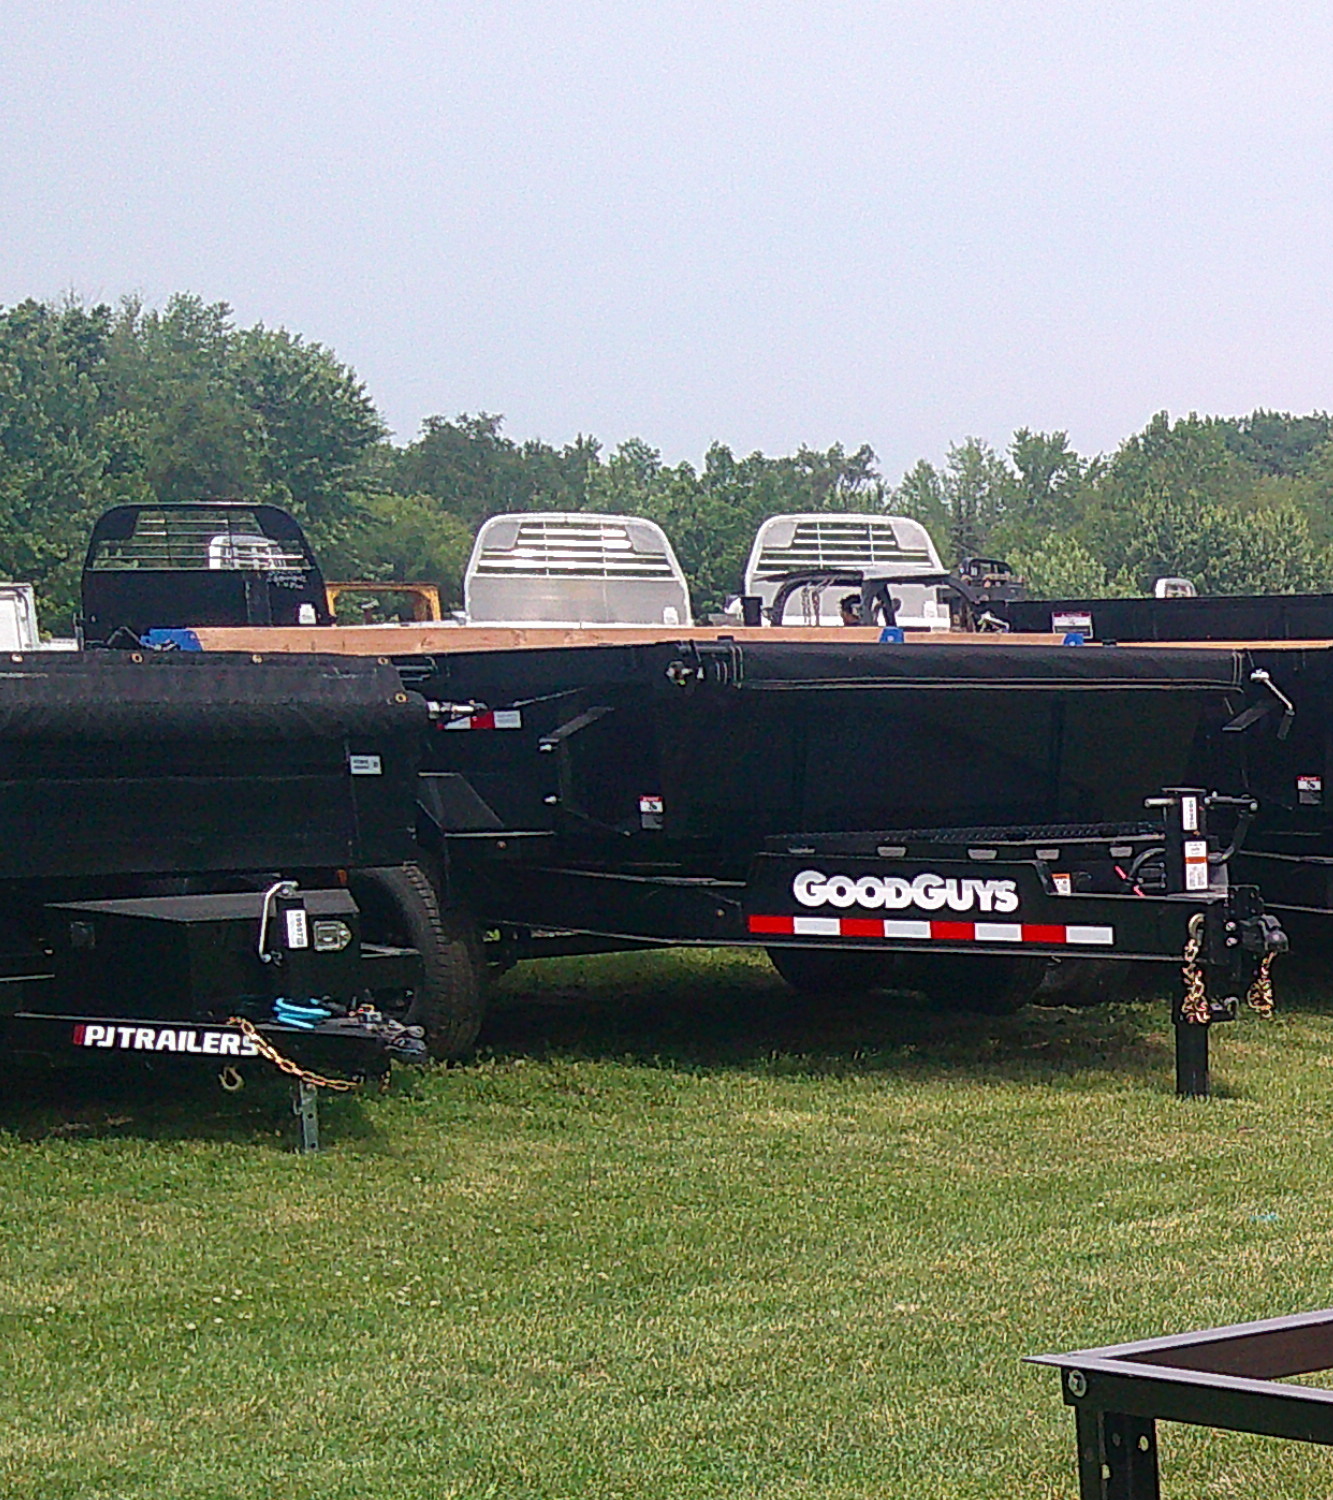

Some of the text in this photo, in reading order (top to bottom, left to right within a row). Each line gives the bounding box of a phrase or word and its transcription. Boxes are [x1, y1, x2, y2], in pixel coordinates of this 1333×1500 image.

[793, 869, 1019, 913] GOODGUYS
[83, 1025, 259, 1056] PJ TRAILERS
